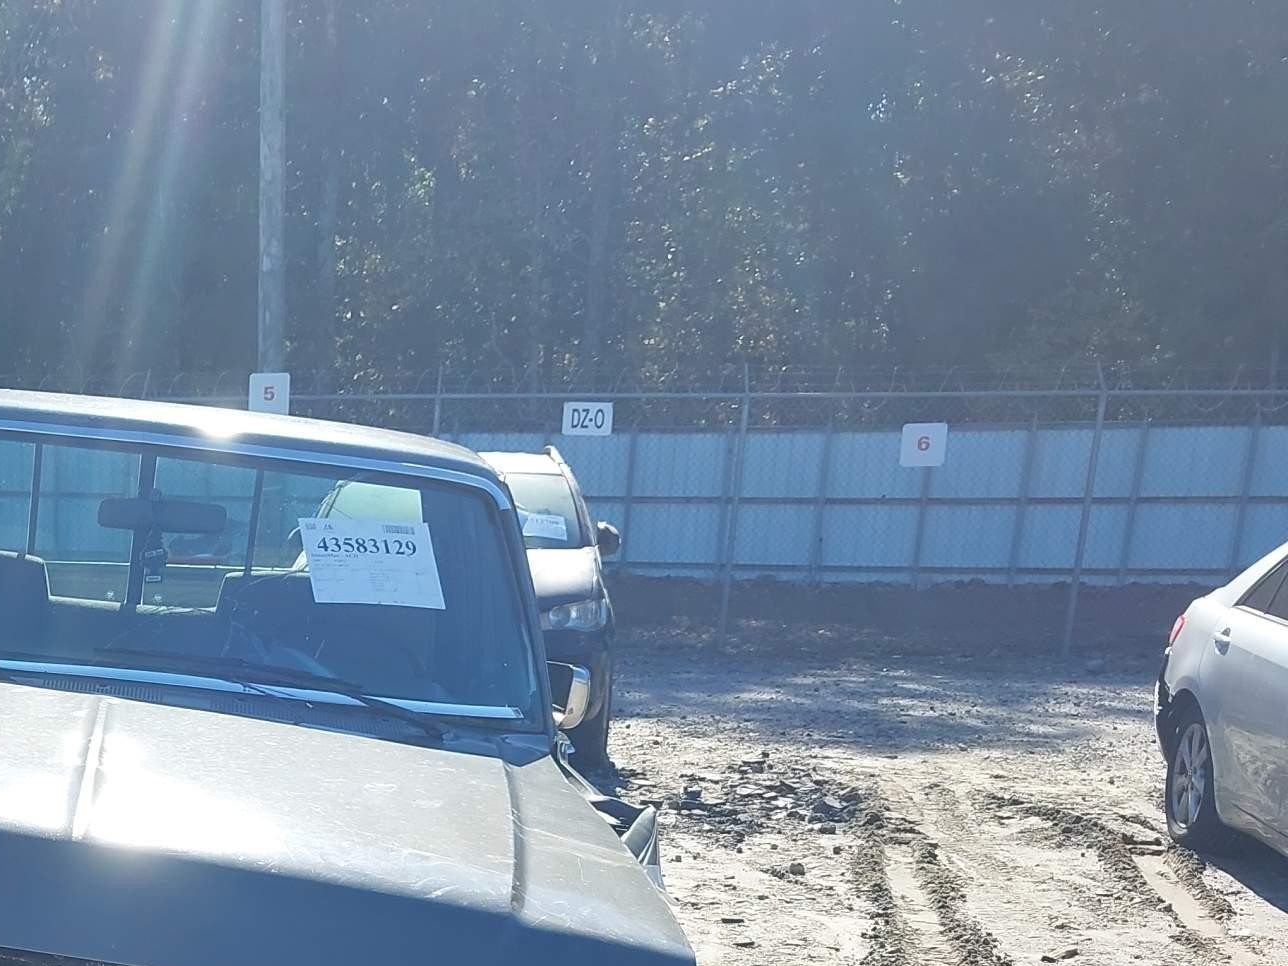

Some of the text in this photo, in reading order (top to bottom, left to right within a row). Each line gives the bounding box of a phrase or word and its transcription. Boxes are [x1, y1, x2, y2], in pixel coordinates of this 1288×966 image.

[264, 386, 275, 401] 5
[917, 436, 930, 451] 6
[317, 536, 417, 557] 43583129
